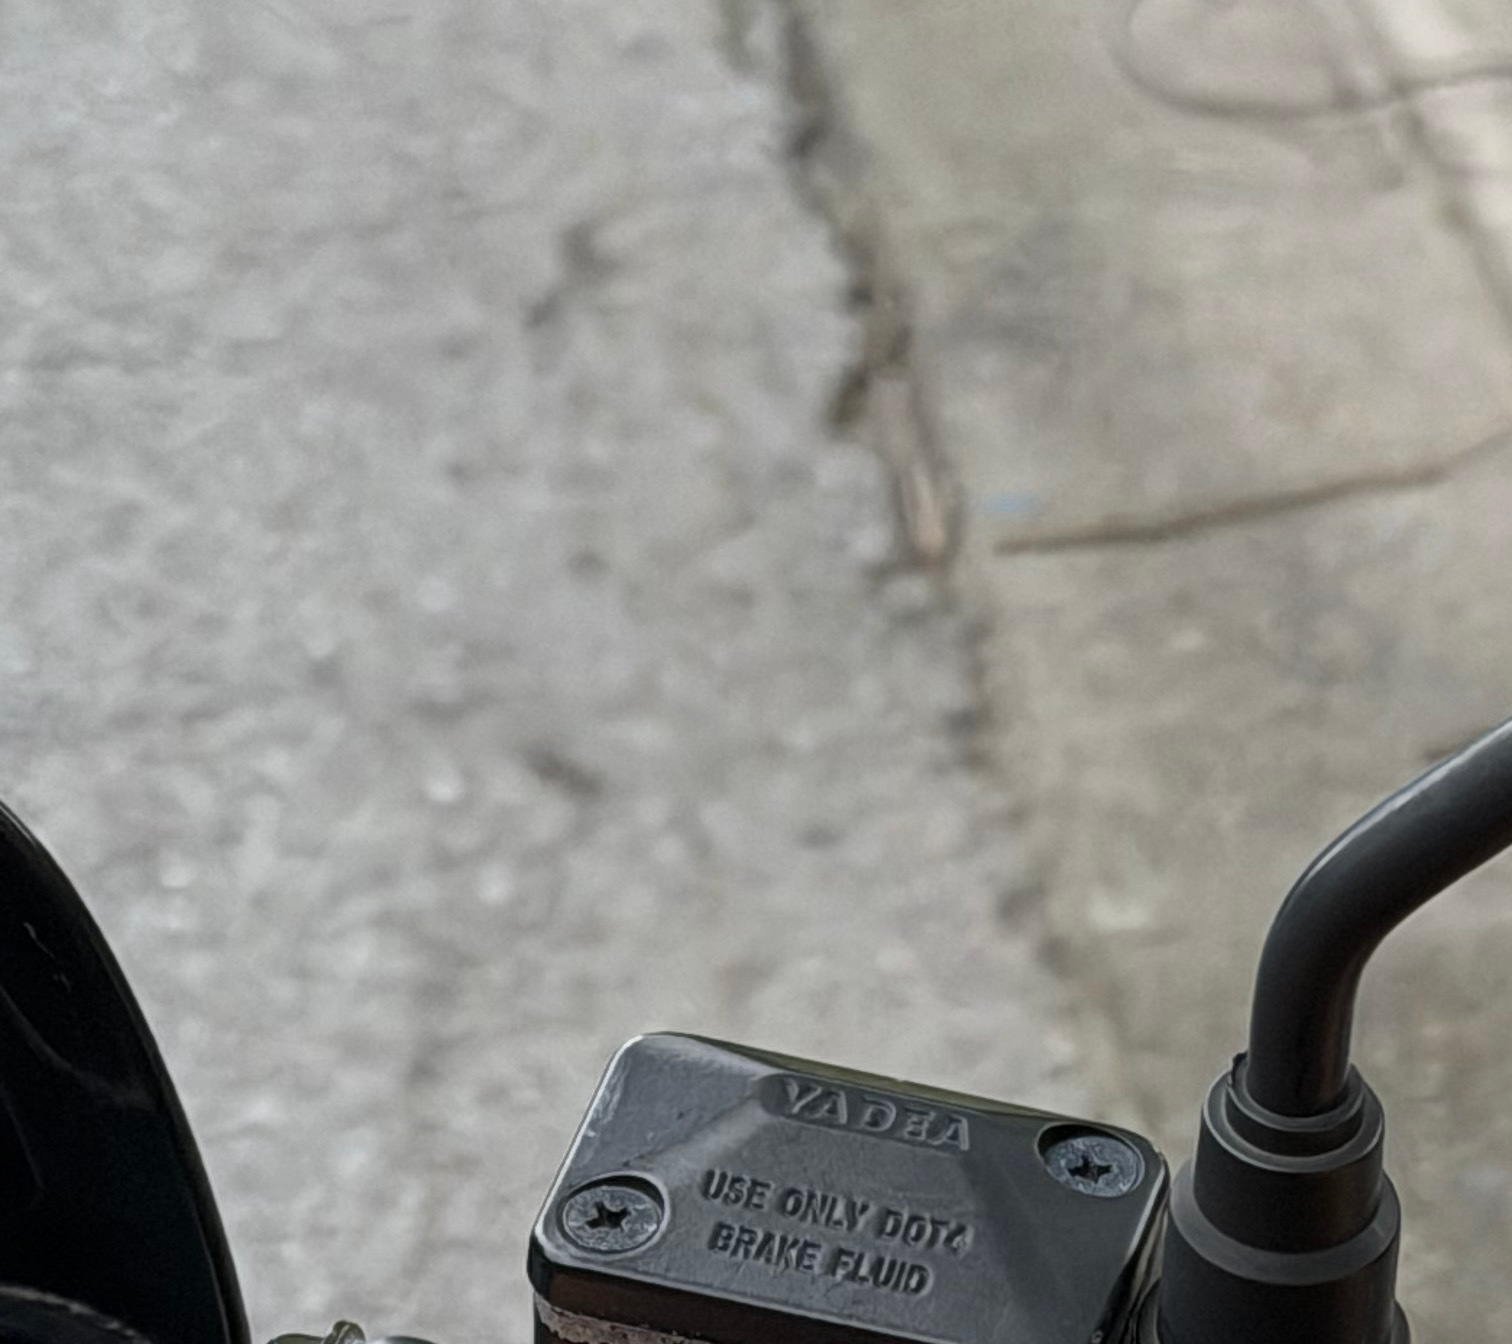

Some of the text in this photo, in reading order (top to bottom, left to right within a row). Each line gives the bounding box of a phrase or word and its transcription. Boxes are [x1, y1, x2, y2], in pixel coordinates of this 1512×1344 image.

[783, 1077, 971, 1152] YADEA
[700, 1168, 976, 1258] USE ONLY DOT4
[707, 1220, 934, 1297] BRAKE FLUID
